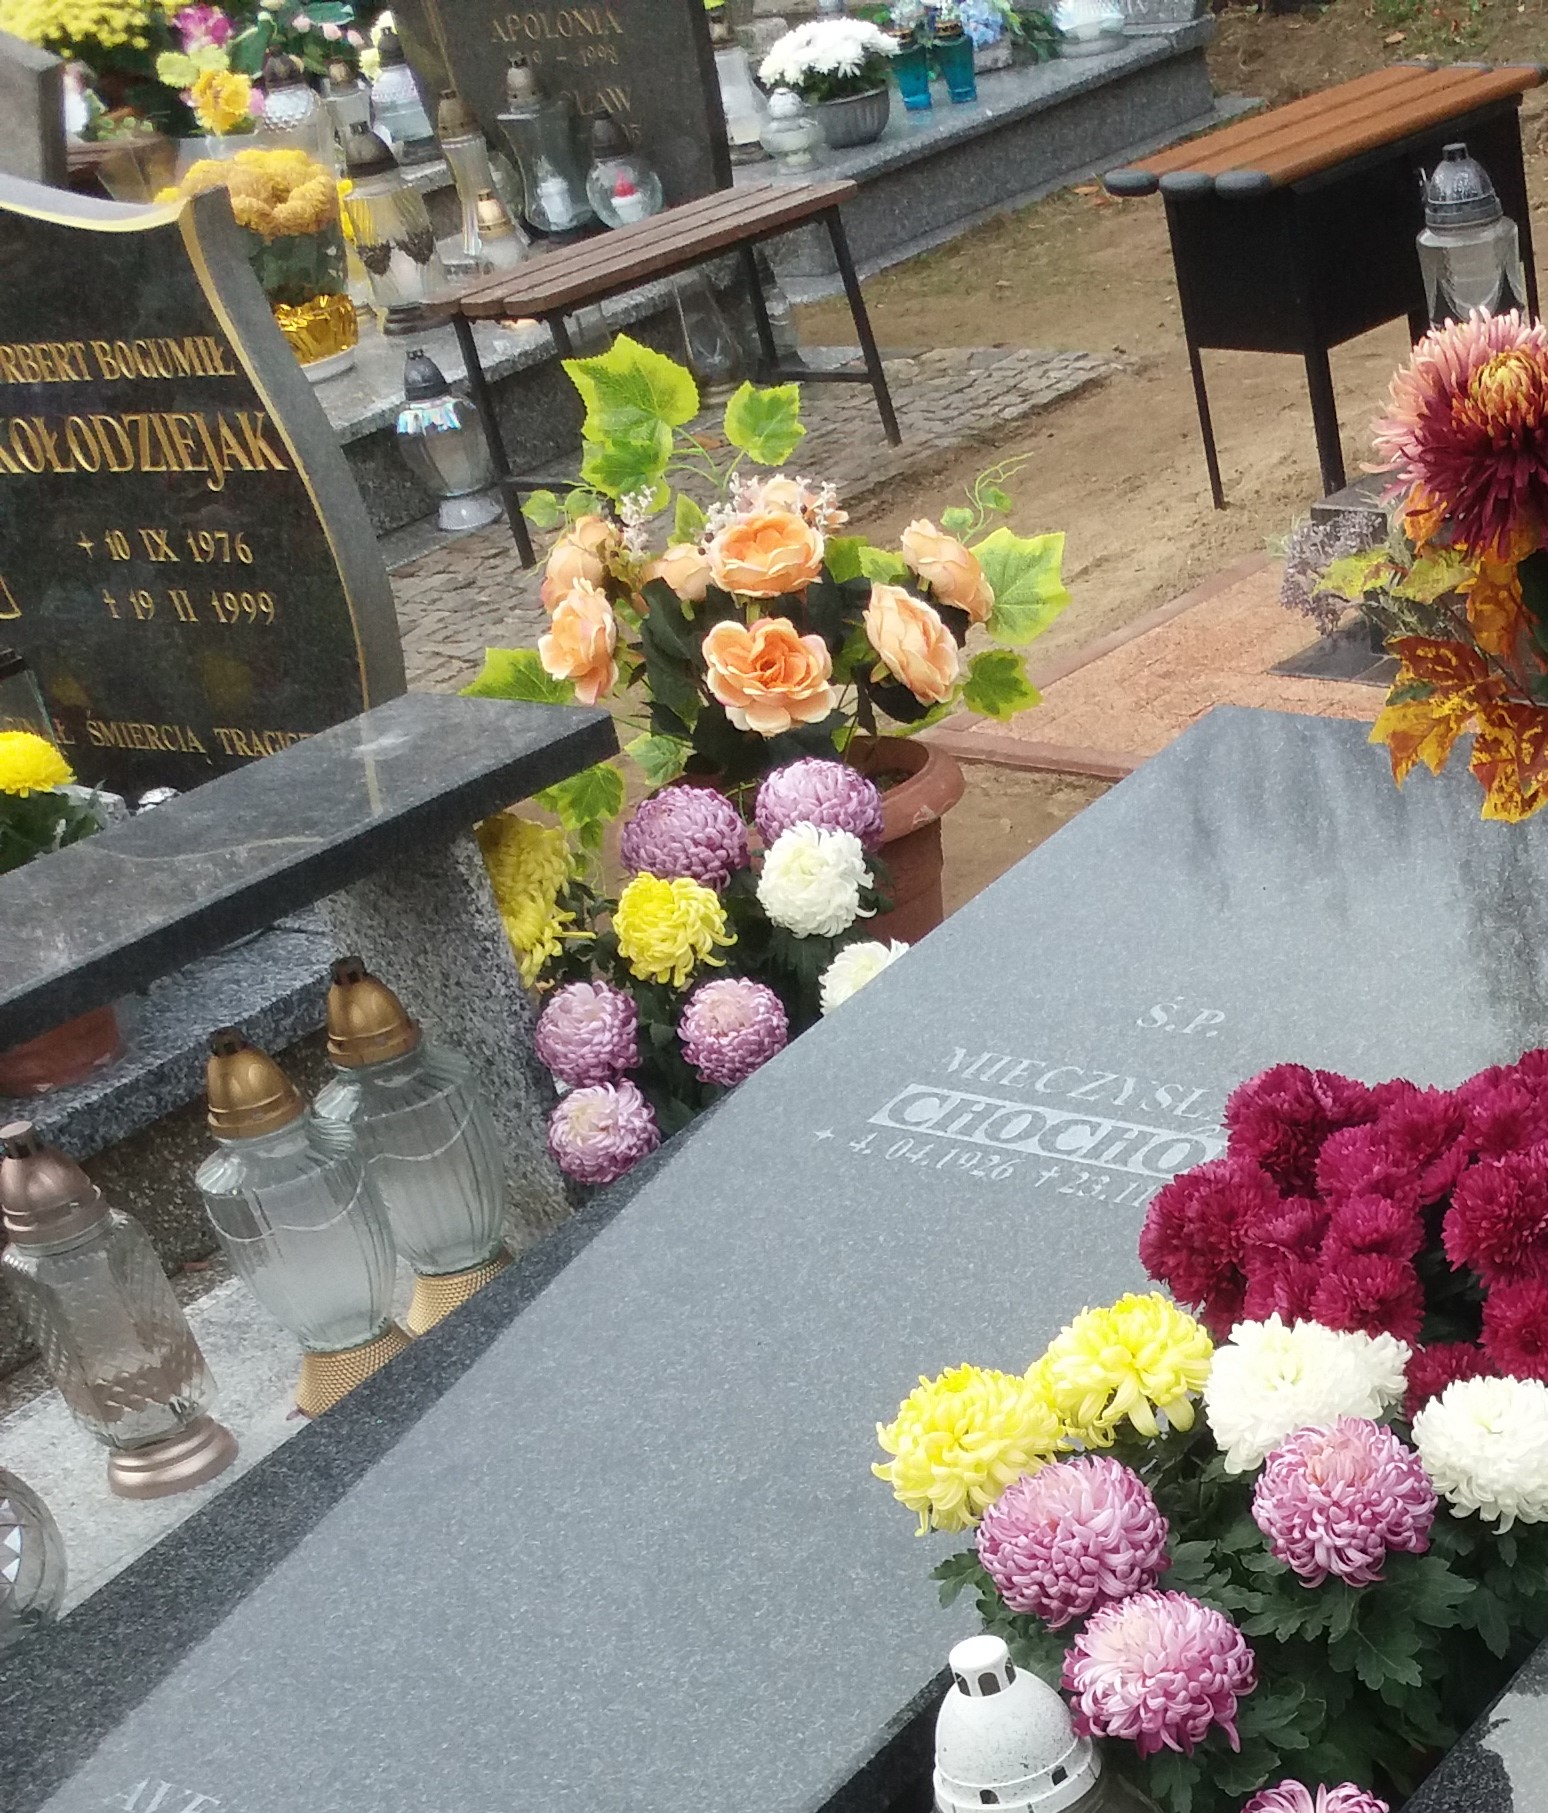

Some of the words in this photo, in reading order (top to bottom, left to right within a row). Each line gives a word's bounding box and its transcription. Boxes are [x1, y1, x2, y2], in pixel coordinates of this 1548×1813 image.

[490, 7, 624, 43] APOLONIA
[89, 336, 237, 380] BOGUMIŁ
[104, 528, 132, 562] 10
[138, 528, 181, 562] IX
[186, 529, 254, 564] 1976
[129, 588, 156, 620] 19
[168, 589, 199, 622] II
[211, 589, 277, 625] 1999
[86, 709, 213, 767] ŚMIERCIĄ
[212, 727, 318, 757] TRAGI
[942, 1046, 1226, 1121] MIECZYSŁ
[876, 1084, 1224, 1178] CHOCHÓ
[1054, 1170, 1158, 1208] 23.11
